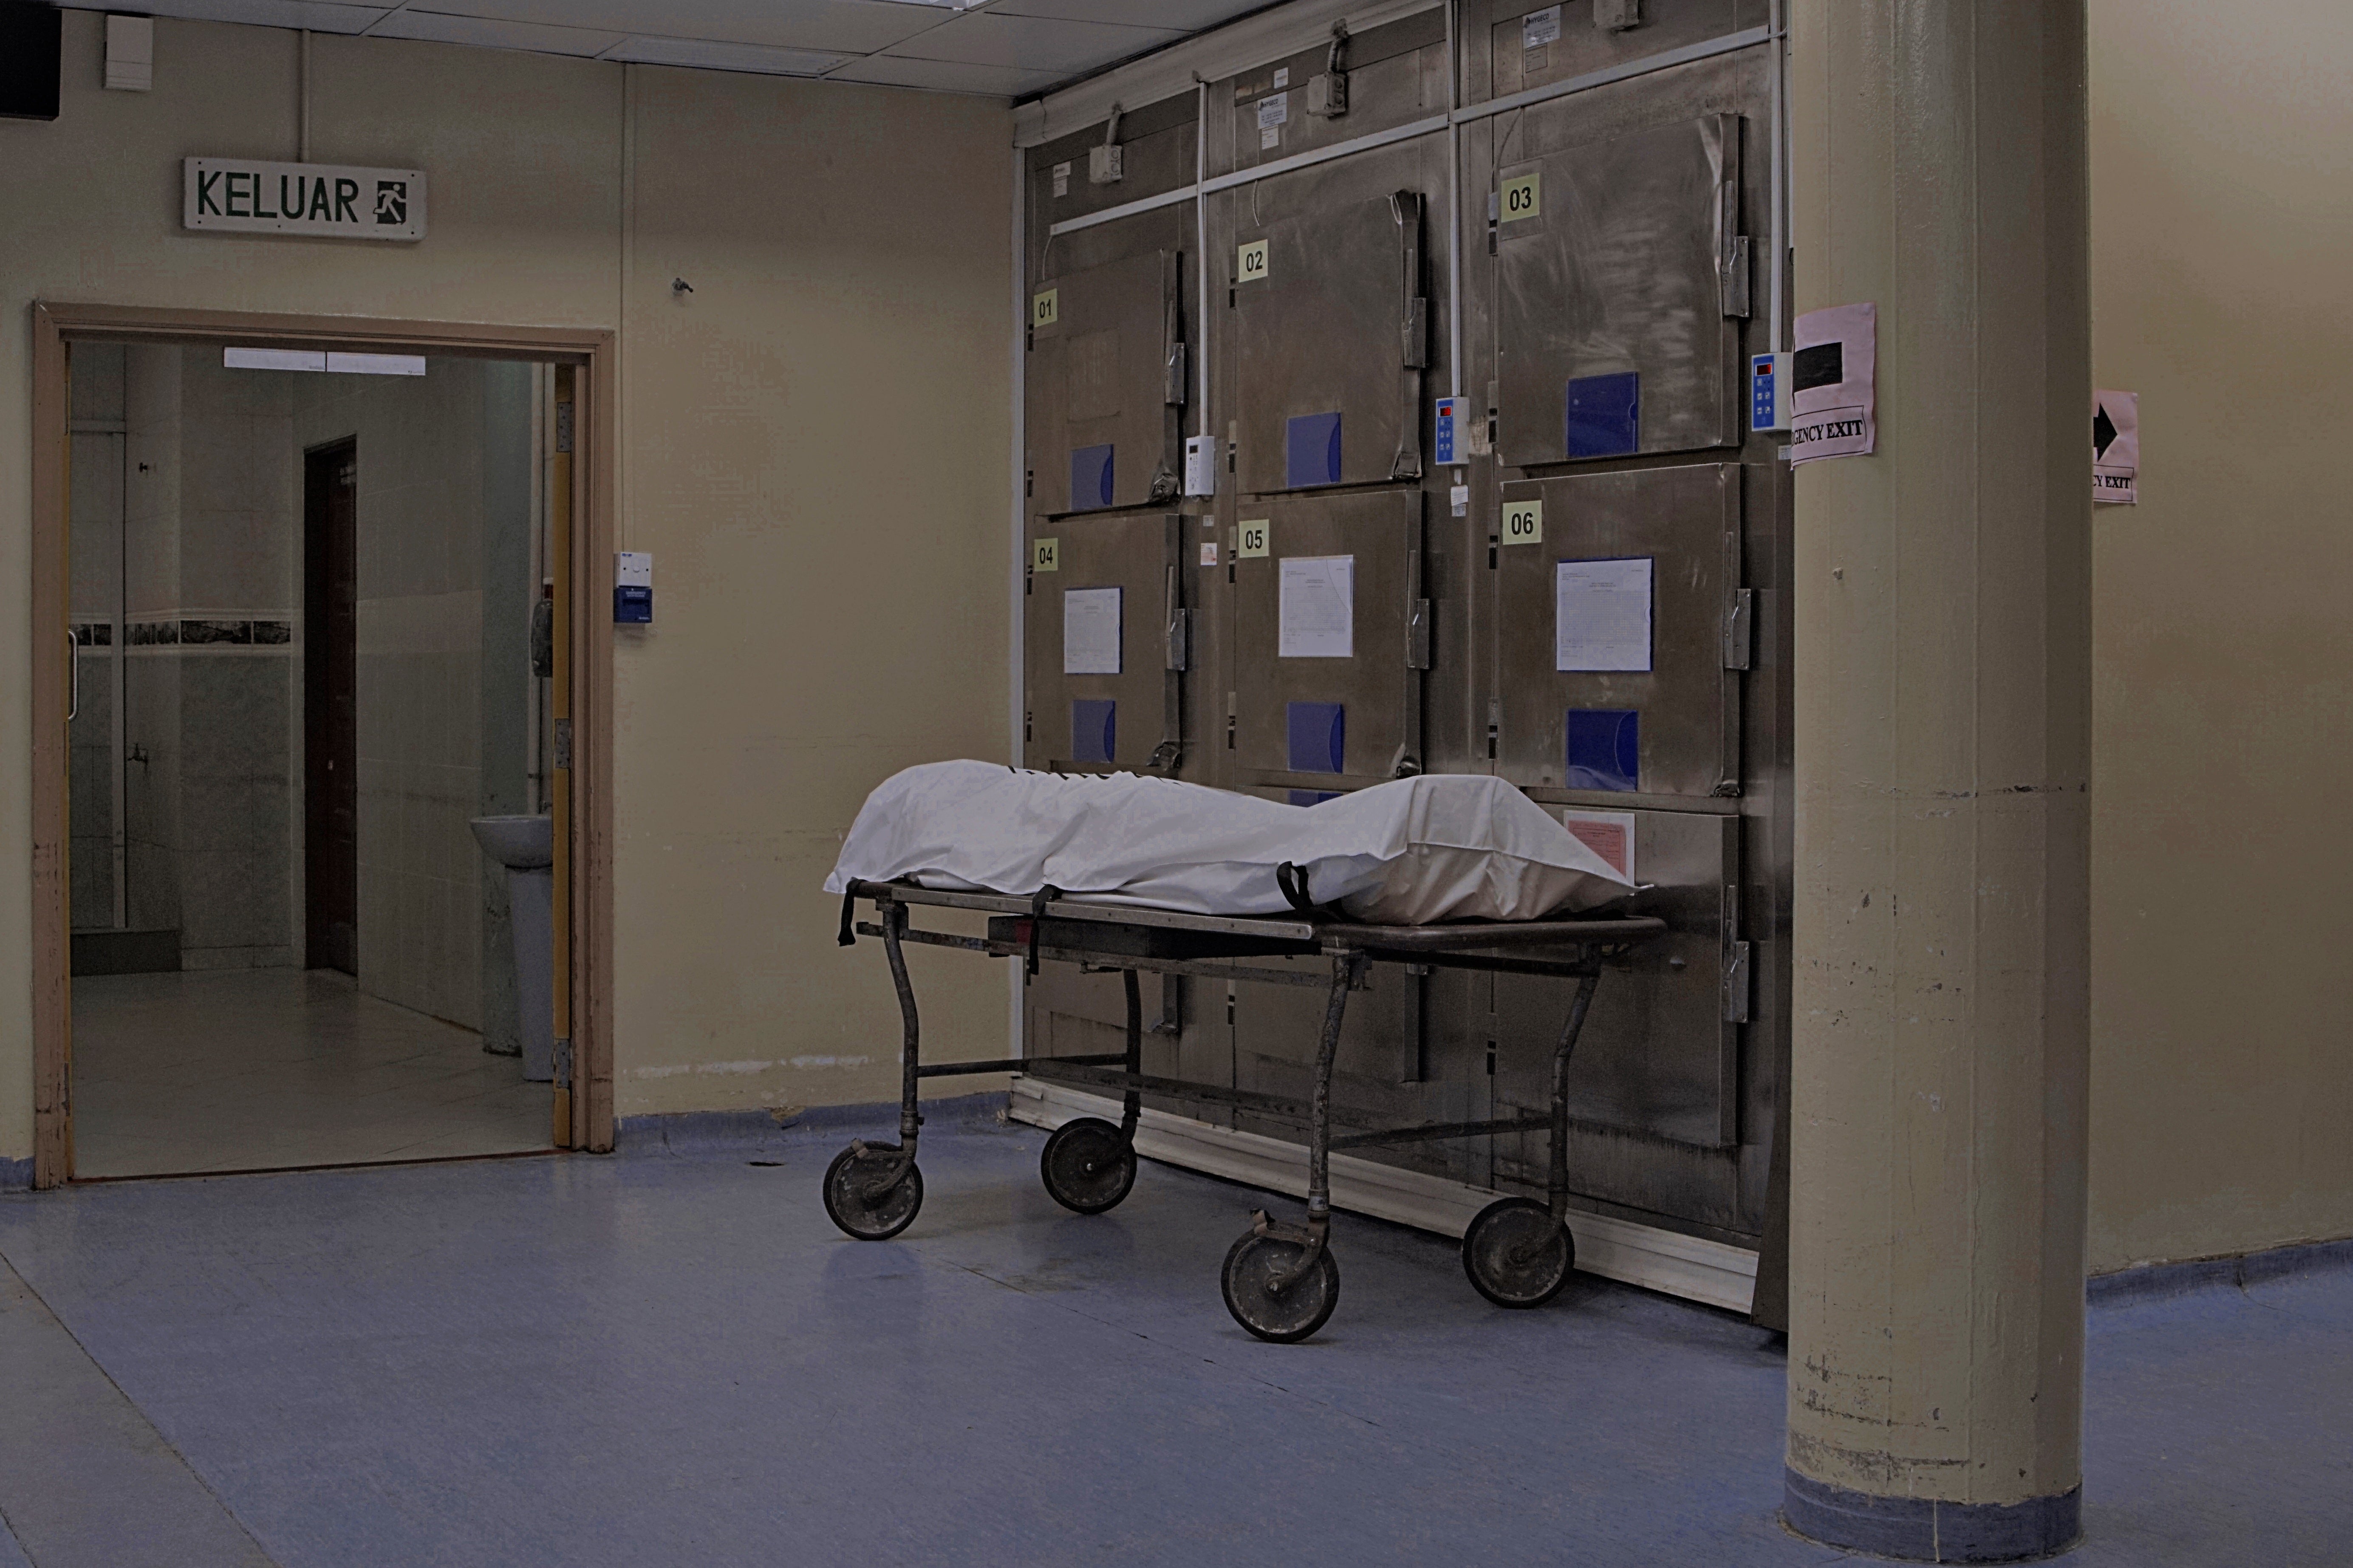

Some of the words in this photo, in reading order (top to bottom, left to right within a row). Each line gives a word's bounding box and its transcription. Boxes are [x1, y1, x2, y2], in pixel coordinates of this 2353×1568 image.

[198, 170, 359, 223] KELUAR
[1510, 186, 1531, 212] 03
[1246, 251, 1263, 272] 02
[1039, 299, 1051, 319] 01
[1827, 420, 1863, 438] EXIT
[2105, 476, 2131, 489] EXIT
[1511, 512, 1533, 535] 06
[1245, 529, 1263, 549] 05
[1039, 546, 1053, 565] 04
